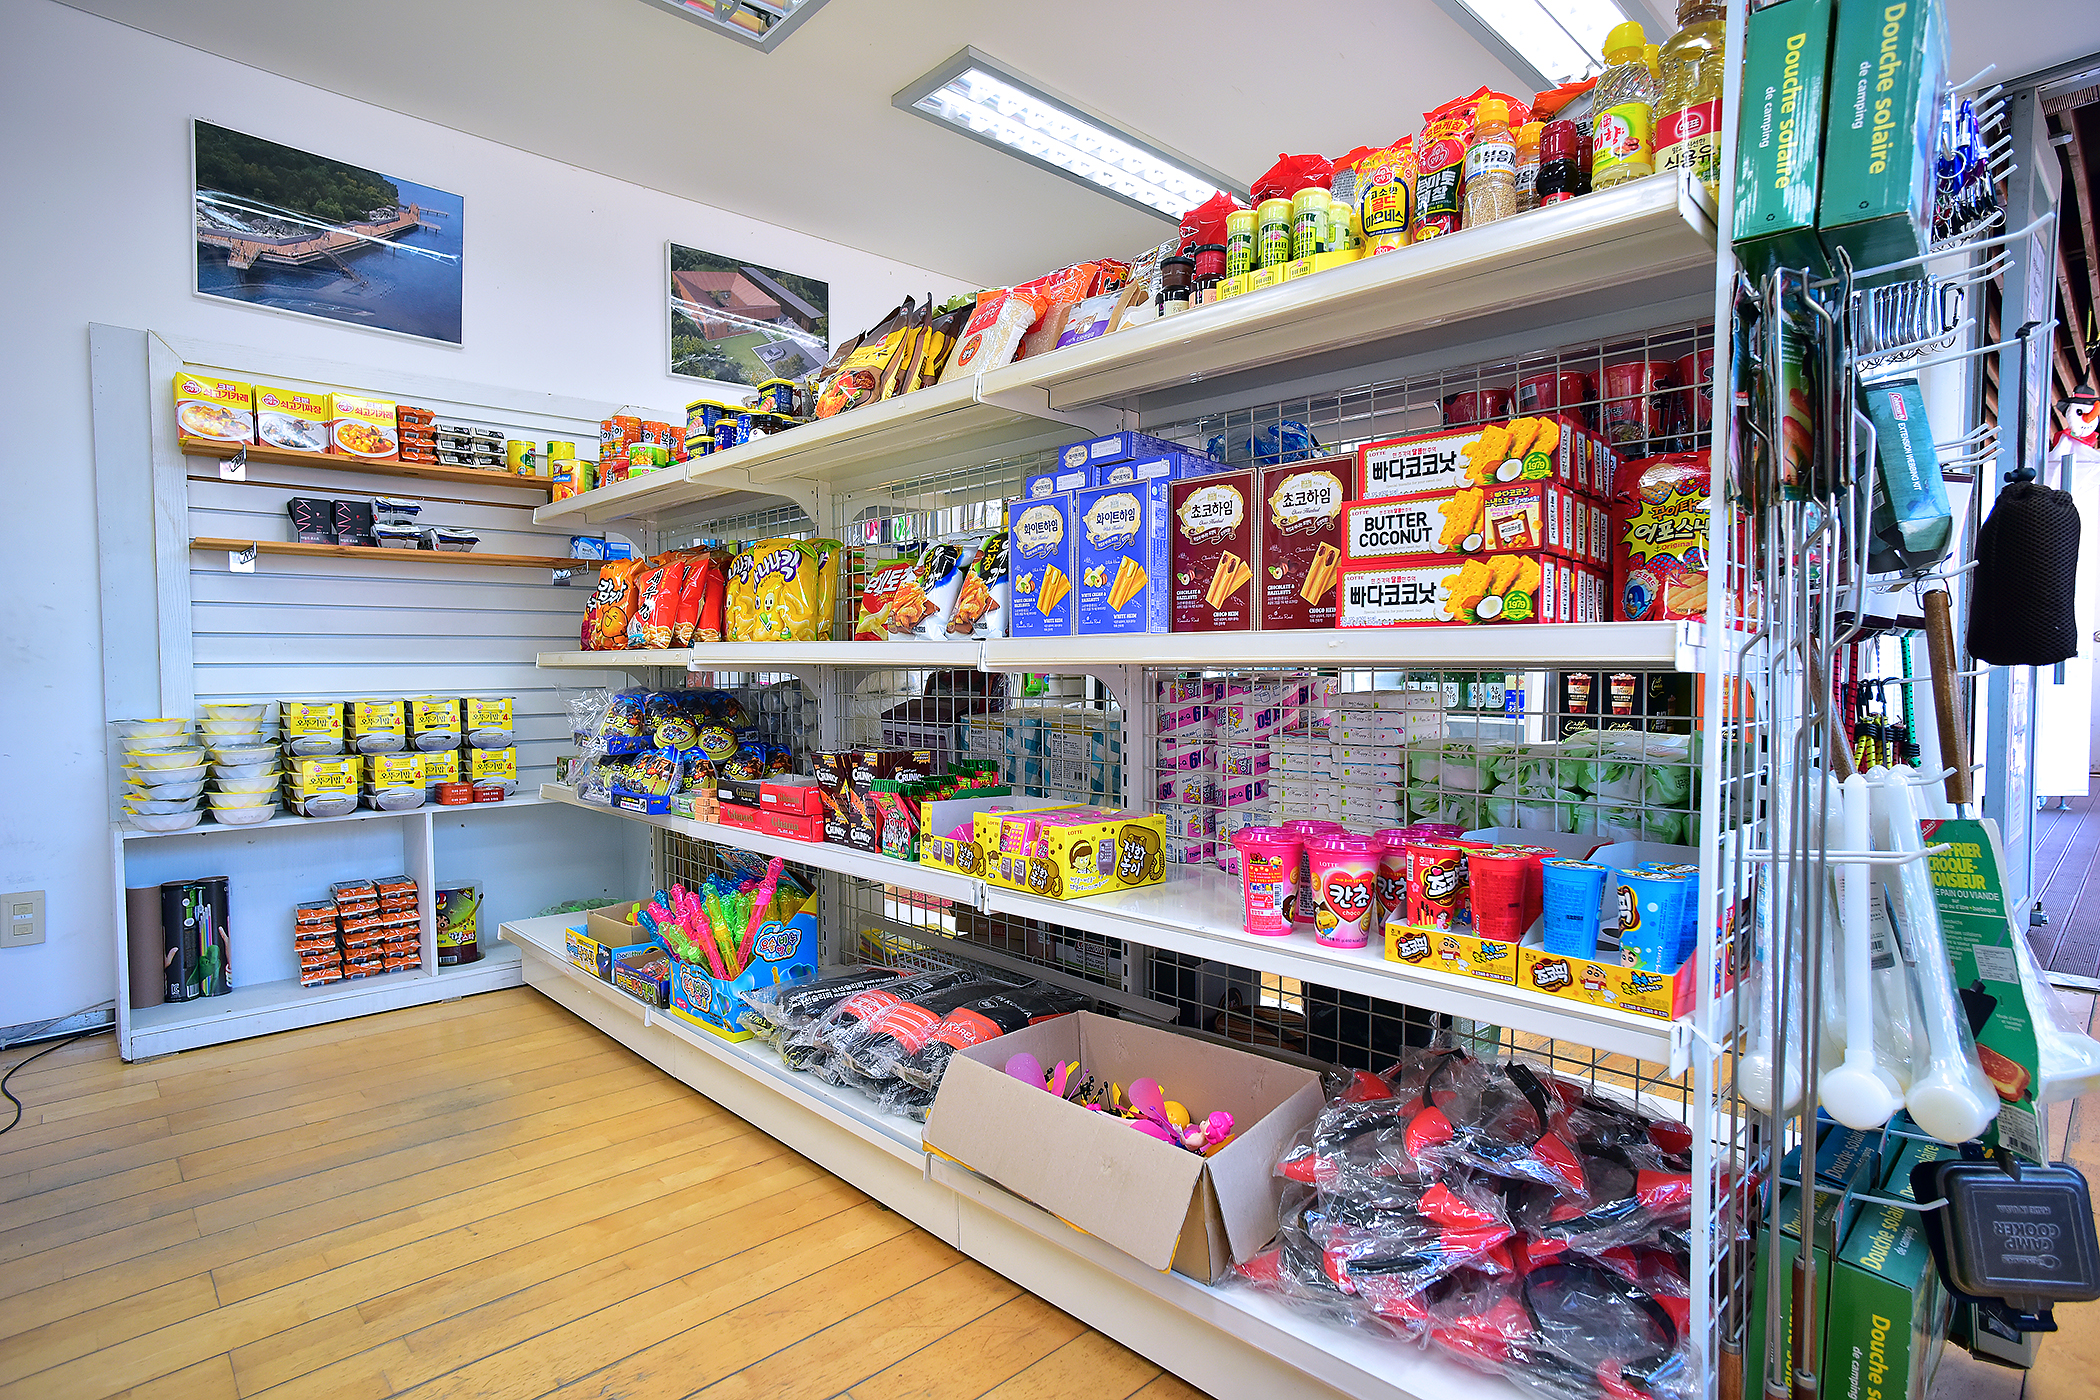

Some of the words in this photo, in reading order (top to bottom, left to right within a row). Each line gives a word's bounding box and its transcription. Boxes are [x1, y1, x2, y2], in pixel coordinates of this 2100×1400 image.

[1877, 4, 1906, 92] Douche
[1781, 33, 1807, 116] Douche
[1860, 61, 1871, 79] de
[1765, 87, 1775, 103] de
[1851, 79, 1870, 130] camping
[1759, 103, 1774, 148] camping
[1869, 97, 1895, 175] solaire
[1775, 118, 1796, 190] solaire
[203, 388, 249, 403] 쇠고기카레
[280, 400, 322, 415] 쇠고기짜장
[1898, 422, 1913, 455] EXTENSION
[1373, 451, 1457, 482] 빠다코코낫
[1528, 461, 1545, 470] 1979
[1904, 454, 1918, 479] WEBBING
[1911, 478, 1922, 490] KIT
[1096, 508, 1136, 525] 화이트하임
[1364, 512, 1428, 532] BUTTER
[1024, 519, 1058, 535] 화이트하임
[1359, 527, 1433, 547] COCONUT
[1661, 541, 1694, 551] Original
[1350, 582, 1436, 607] 빠다코코낫
[1508, 600, 1526, 609] 1979
[332, 719, 339, 728] 4
[394, 717, 401, 726] 4
[450, 715, 456, 724] 4
[502, 713, 509, 721] 4
[415, 770, 422, 779] 4
[449, 765, 454, 773] 4
[346, 775, 353, 784] 4
[736, 787, 756, 799] Ghana
[778, 793, 799, 804] Ghana
[727, 808, 754, 823] Ghana
[771, 816, 799, 831] Ghana
[1123, 840, 1147, 860] 전화
[1120, 861, 1145, 877] 놀이
[1941, 889, 1956, 897] PAIN
[1957, 890, 1969, 899] OU
[1970, 890, 2000, 901] VIANDE
[1825, 1149, 1854, 1179] Douche
[1993, 1221, 2061, 1239] COOKER
[1860, 1228, 1895, 1271] Douche
[2004, 1237, 2054, 1253] CAMP
[1852, 1346, 1862, 1360] de
[1868, 1313, 1892, 1378] Douche
